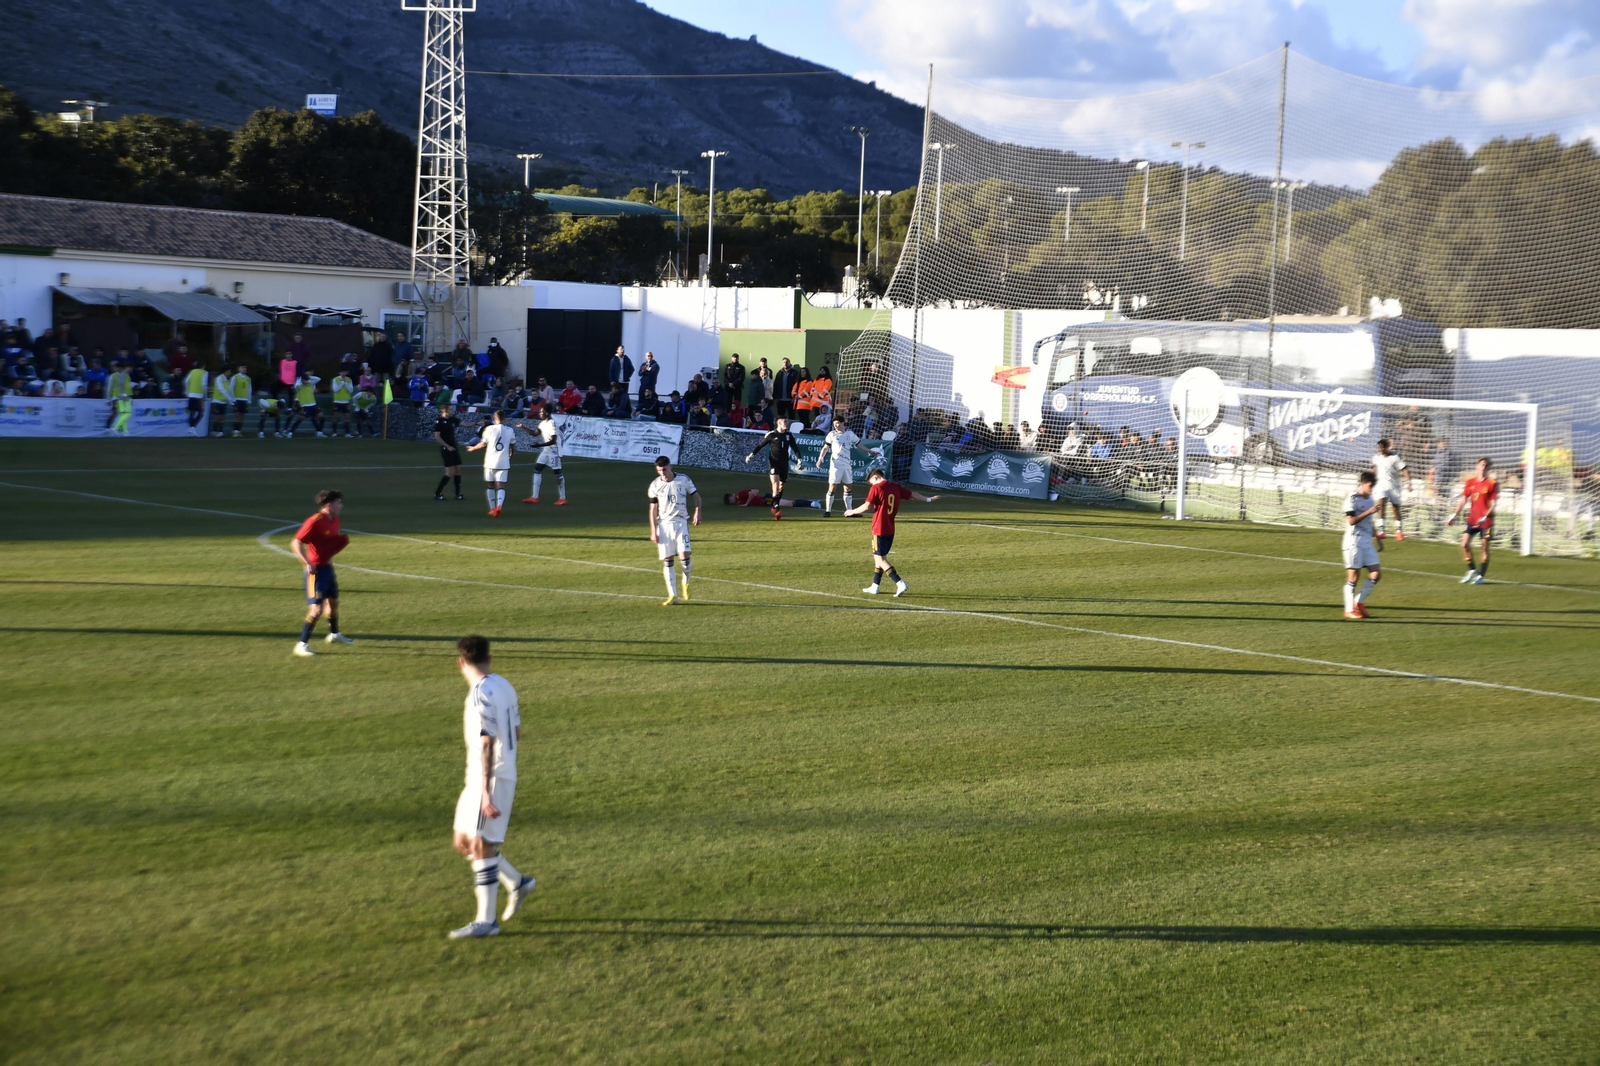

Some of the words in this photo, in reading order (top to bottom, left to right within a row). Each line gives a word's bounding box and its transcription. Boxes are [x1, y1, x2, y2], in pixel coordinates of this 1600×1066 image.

[1097, 385, 1139, 395] JUVENTUD
[611, 429, 627, 437] bizum
[1288, 411, 1371, 452] VERDES!
[495, 437, 504, 451] 6
[930, 477, 1030, 495] comercialtorremolinoscosta.com
[887, 493, 896, 515] 9
